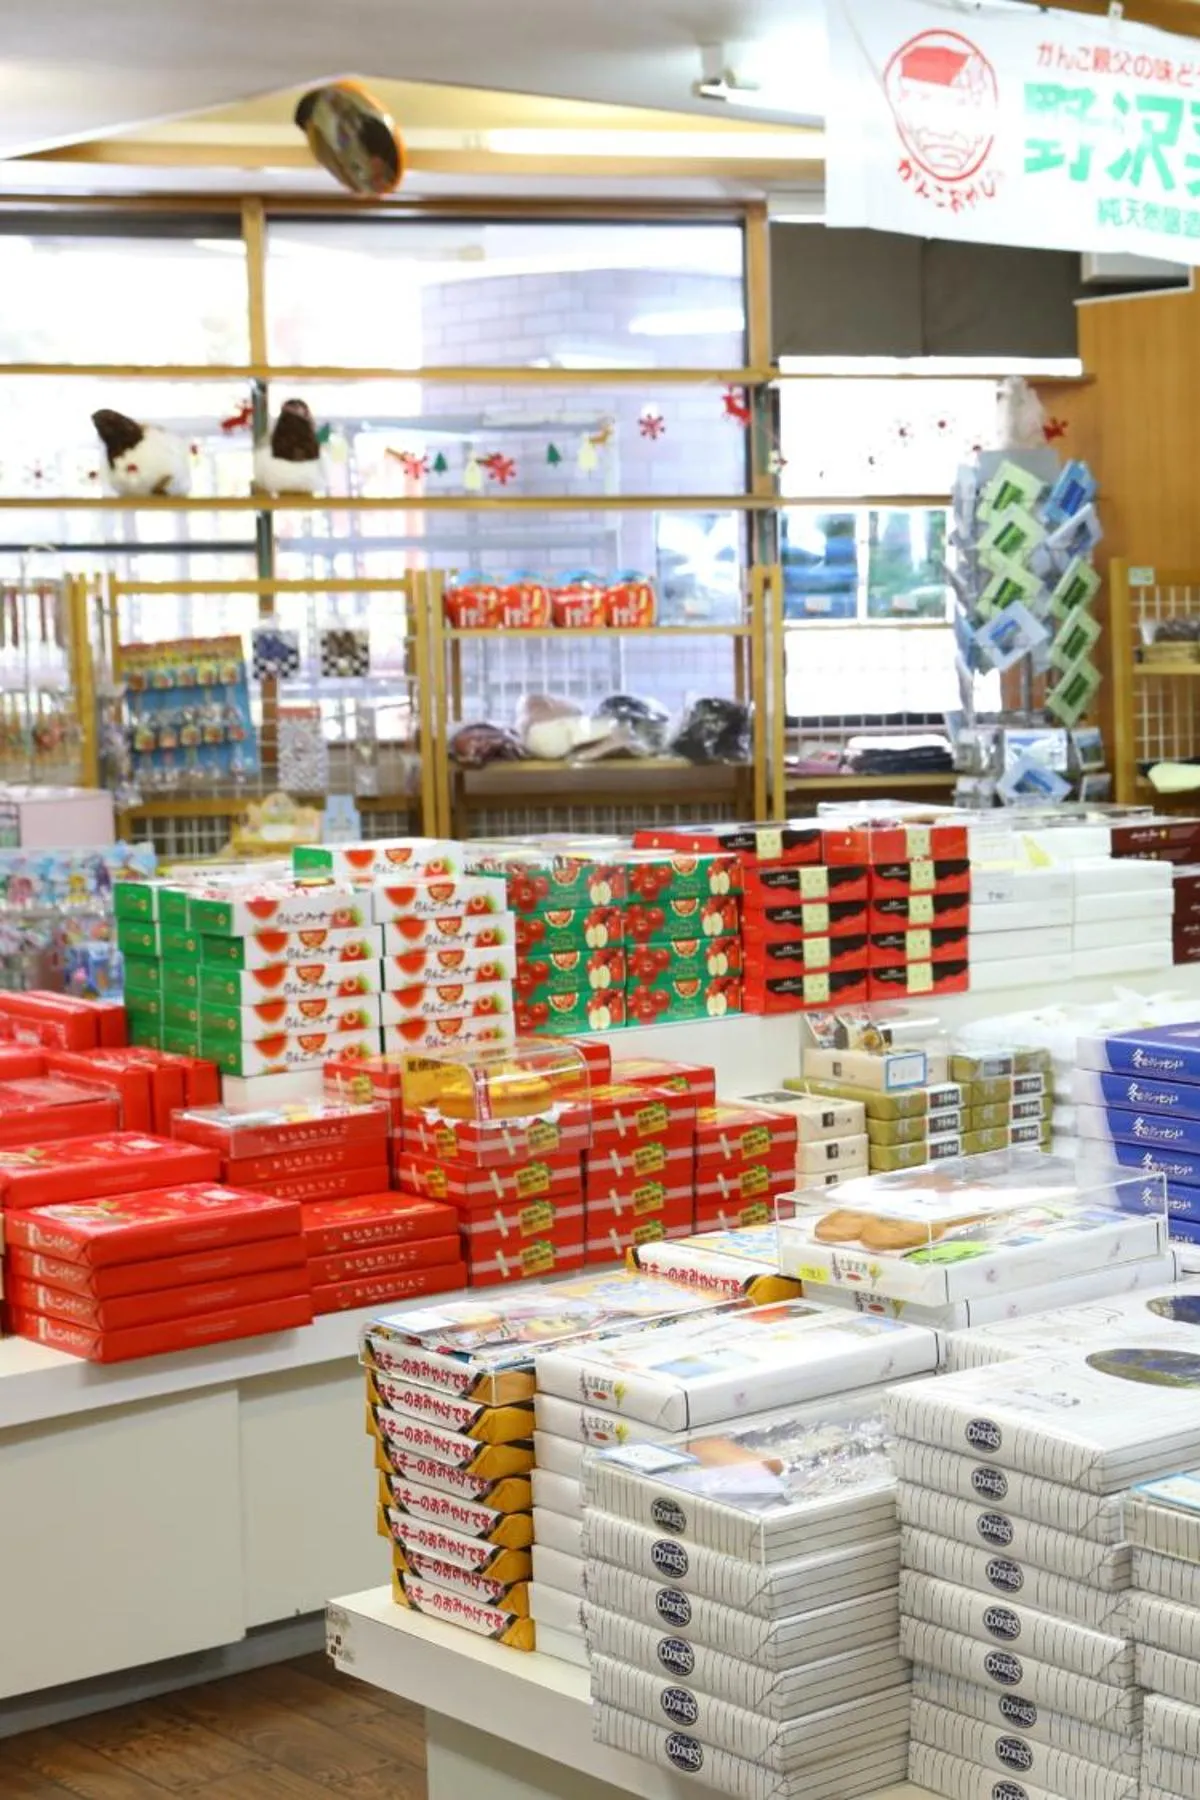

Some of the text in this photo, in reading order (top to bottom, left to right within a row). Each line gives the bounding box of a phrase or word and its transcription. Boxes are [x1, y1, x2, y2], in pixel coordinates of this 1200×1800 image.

[967, 1426, 1001, 1448] COOKIES
[972, 1474, 1008, 1496] COOKIES
[978, 1520, 1014, 1542] COOKIES
[652, 1547, 688, 1572] COOKIES
[987, 1566, 1024, 1589] COOKIES
[656, 1596, 691, 1622] COOKIES
[983, 1614, 1021, 1637] COOKIES
[658, 1645, 695, 1671] COOKIES
[984, 1659, 1023, 1682] COOKIES
[662, 1695, 698, 1722] COOKIES
[666, 1741, 702, 1768] COOKIES
[996, 1743, 1033, 1767] COOKIES
